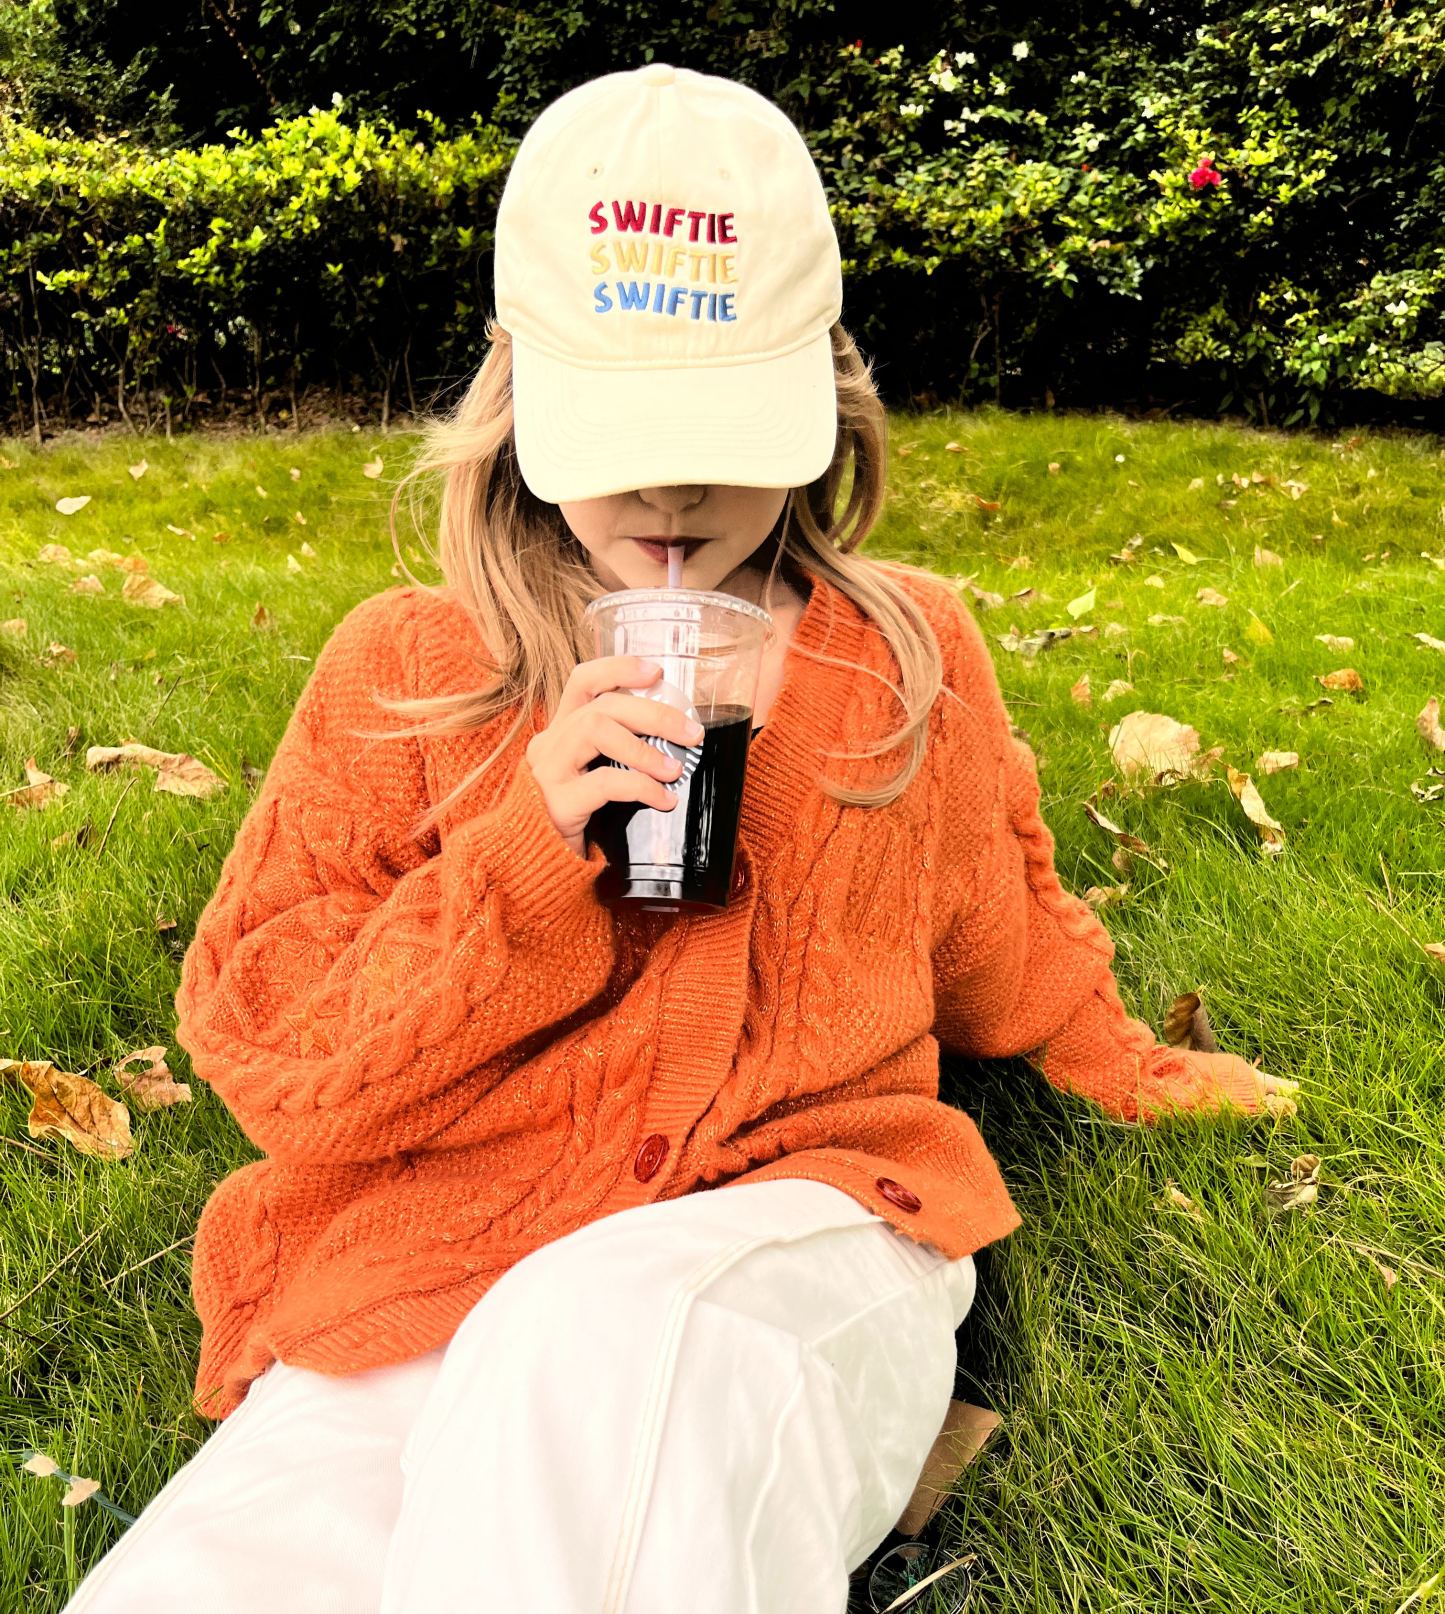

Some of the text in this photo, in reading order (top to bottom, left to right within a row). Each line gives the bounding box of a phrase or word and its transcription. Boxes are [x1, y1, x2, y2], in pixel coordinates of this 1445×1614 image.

[588, 200, 738, 244] SWIFTIE
[589, 241, 738, 284] SWIFTIE
[593, 281, 737, 321] SWIFTIE
